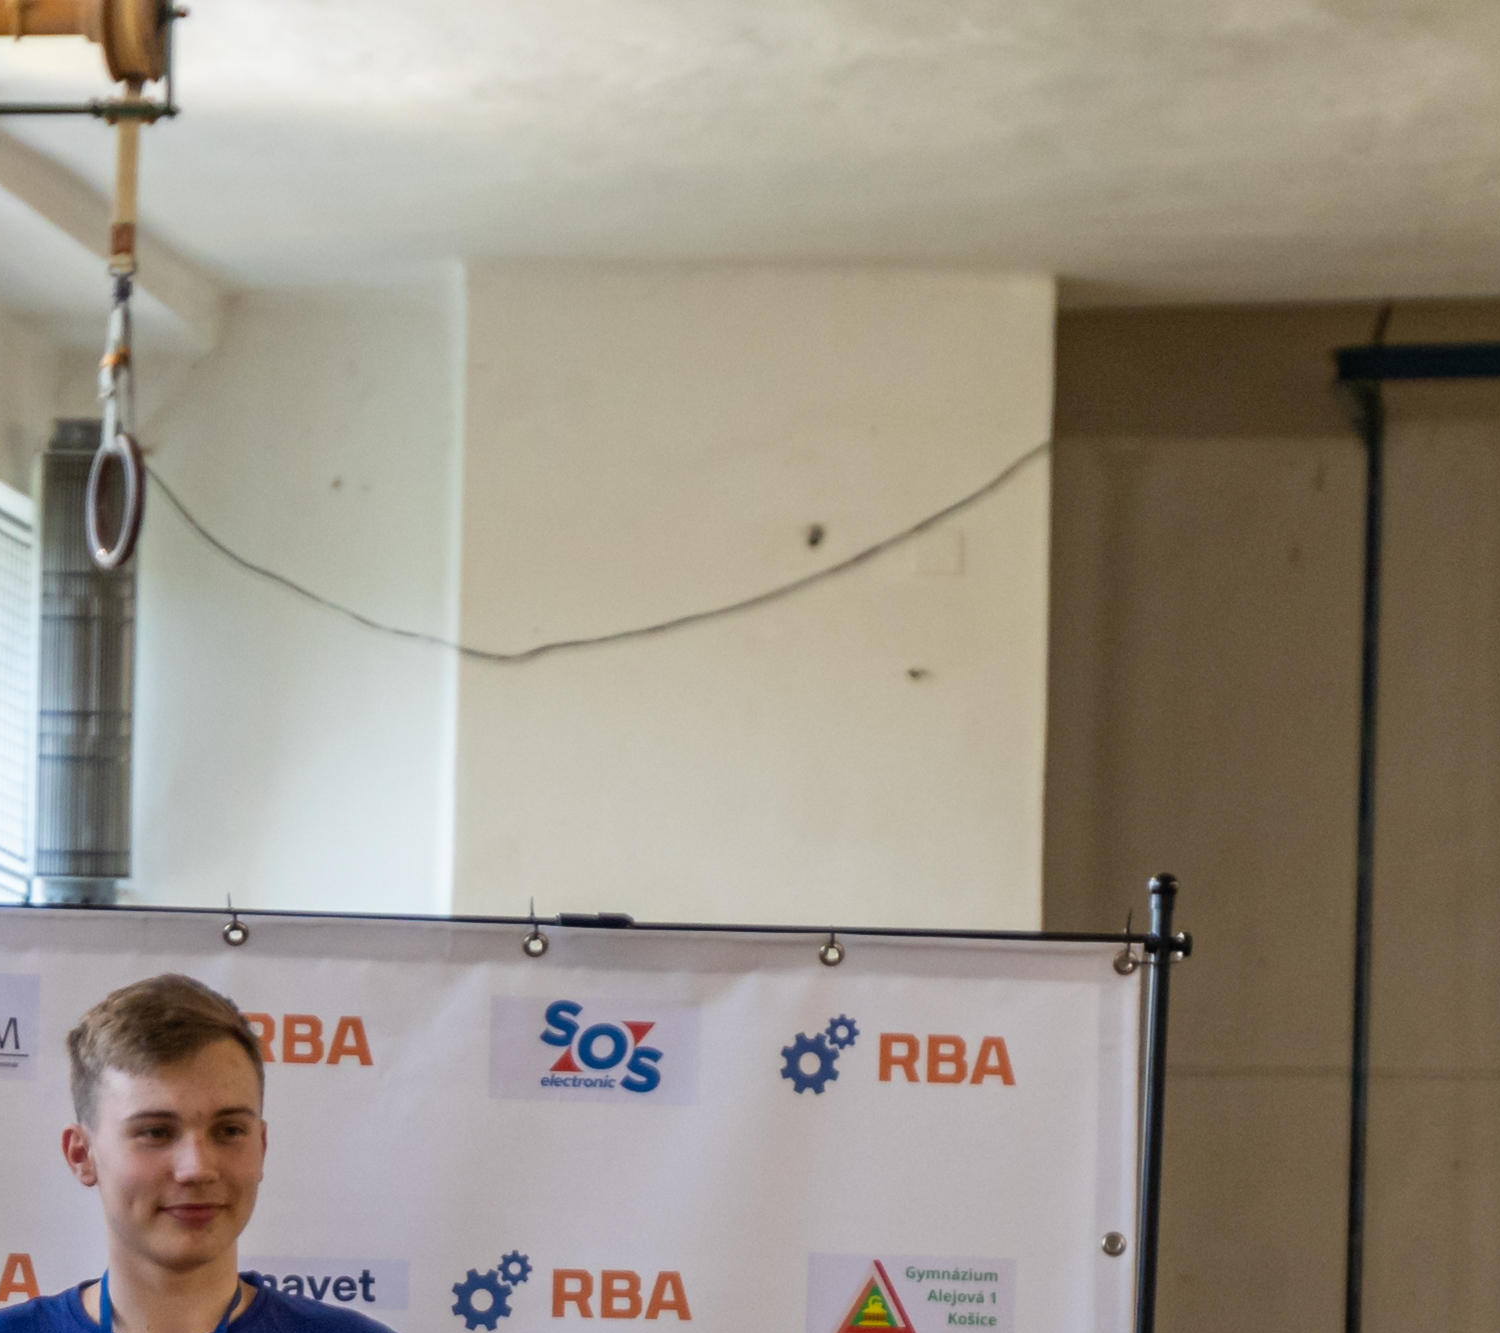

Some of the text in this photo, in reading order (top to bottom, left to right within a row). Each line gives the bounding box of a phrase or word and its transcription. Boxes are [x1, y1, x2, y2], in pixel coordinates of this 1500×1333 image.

[244, 1012, 374, 1066] RBA
[877, 1032, 1016, 1087] RBA
[539, 1070, 616, 1090] electronic
[262, 1269, 376, 1302] avet
[905, 1266, 999, 1285] Gymnázium
[552, 1269, 692, 1322] RBA
[927, 1287, 998, 1308] Alejová 1
[947, 1309, 998, 1328] Košice
